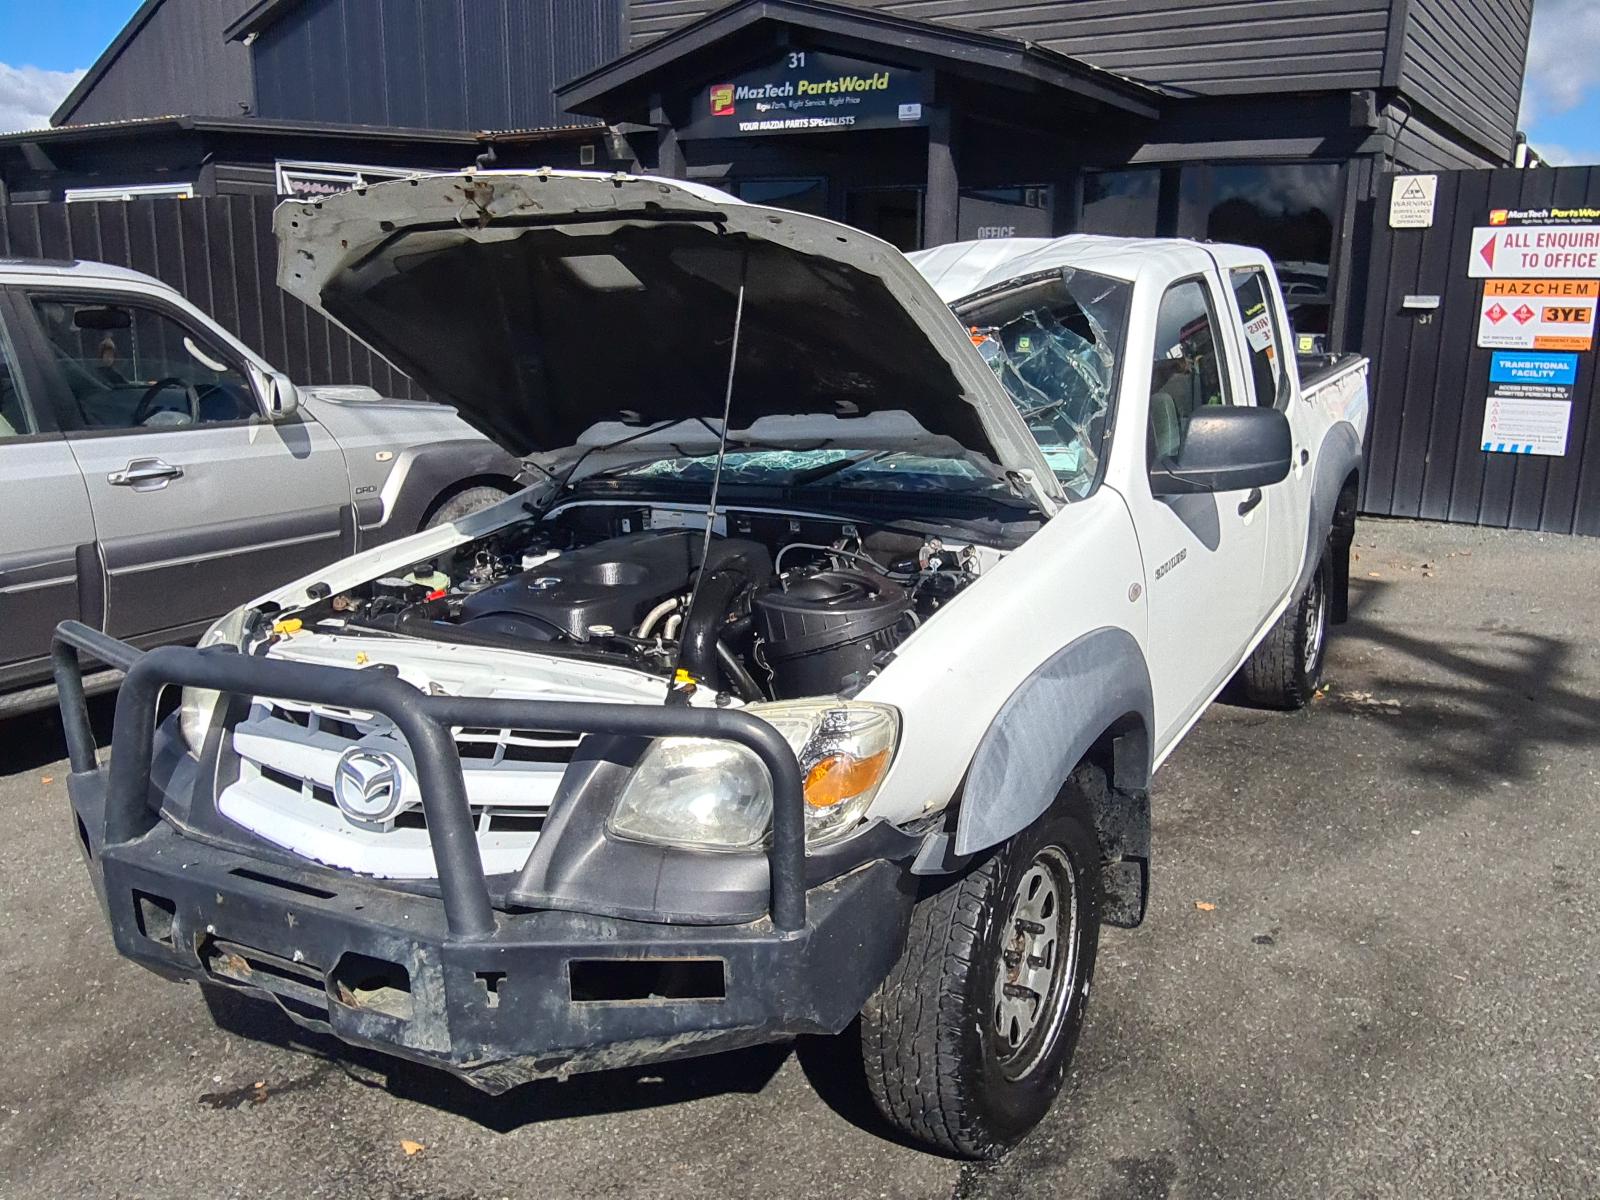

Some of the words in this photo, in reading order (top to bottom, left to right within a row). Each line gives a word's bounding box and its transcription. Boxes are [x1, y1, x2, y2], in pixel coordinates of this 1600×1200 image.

[788, 52, 805, 68] 31
[735, 82, 793, 100] MazTech
[797, 72, 889, 95] PartsWorld
[739, 121, 759, 132] YOUR
[760, 120, 785, 131] MAZDA
[785, 118, 809, 129] PARTS
[809, 115, 856, 128] SPECIALISTS
[1508, 209, 1548, 218] MazTech
[977, 226, 1016, 239] OFFICE
[1504, 233, 1530, 248] ALL
[1536, 232, 1600, 250] ENQUIRI
[1521, 253, 1540, 268] TO
[1544, 252, 1598, 268] OFFICE
[1494, 282, 1589, 295] HAZCHEM
[1418, 313, 1433, 324] 31
[1546, 307, 1587, 322] 3YE
[1499, 360, 1570, 370] TRANSITIONAL
[1511, 369, 1555, 378] FACILITY
